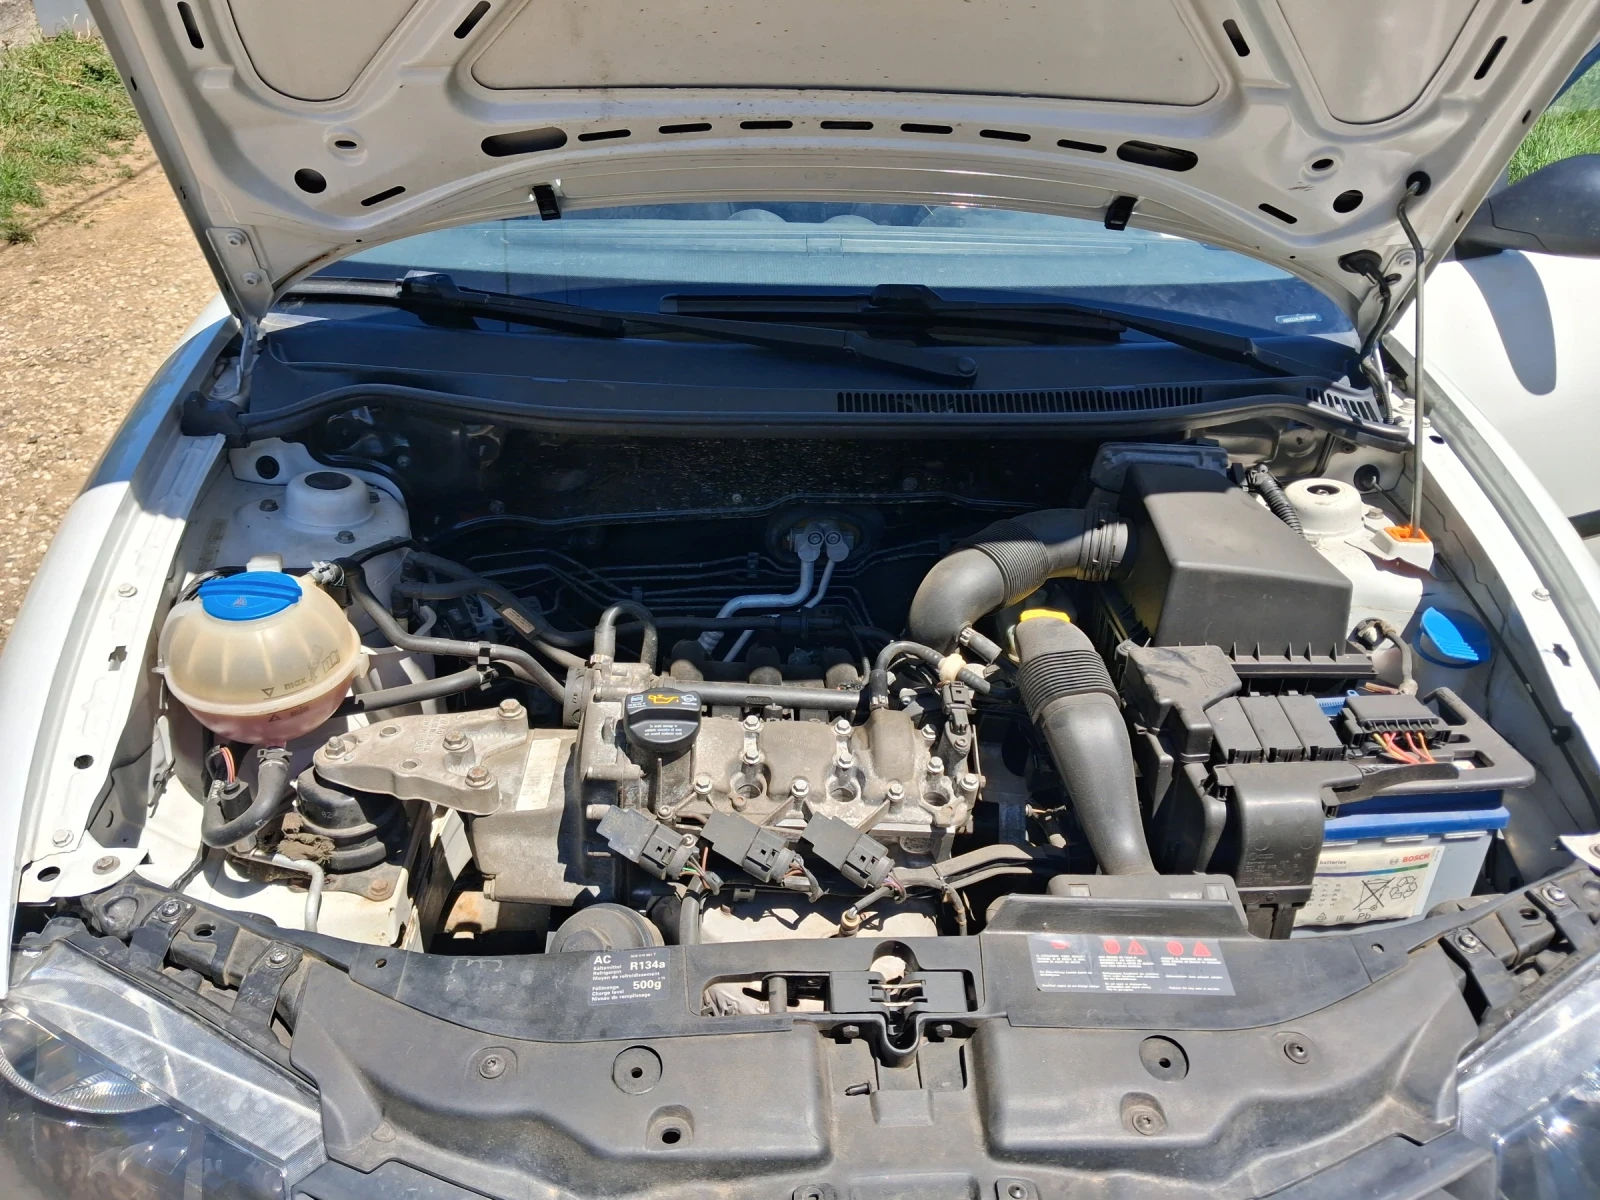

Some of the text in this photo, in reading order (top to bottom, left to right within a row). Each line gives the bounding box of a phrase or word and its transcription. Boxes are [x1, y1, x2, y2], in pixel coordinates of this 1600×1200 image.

[284, 677, 307, 690] max
[1402, 852, 1430, 863] BOSCH
[1357, 912, 1372, 920] Pb
[594, 955, 612, 964] AC
[630, 960, 666, 970] R134a
[632, 980, 662, 990] 500g
